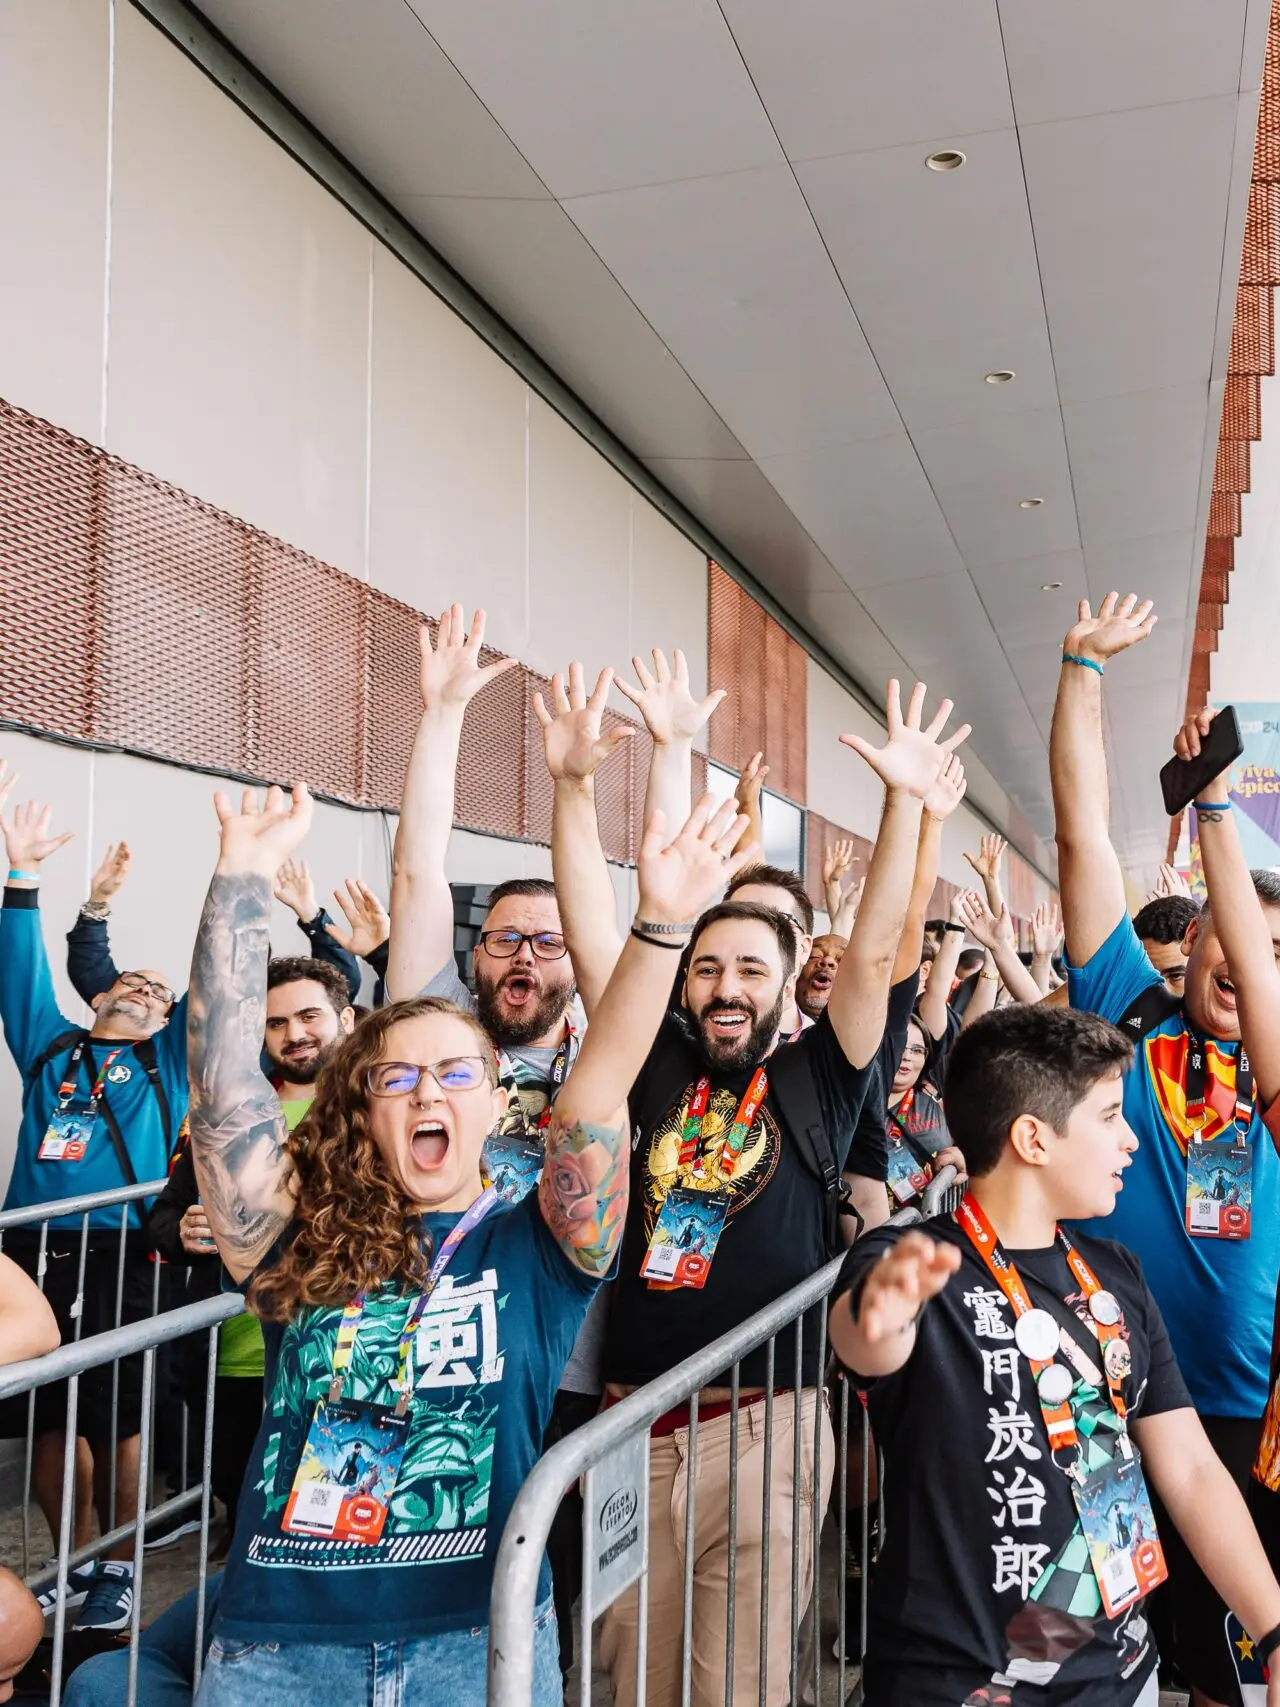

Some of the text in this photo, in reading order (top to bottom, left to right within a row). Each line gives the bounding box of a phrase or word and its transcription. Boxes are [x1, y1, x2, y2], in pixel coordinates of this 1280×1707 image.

[553, 1056, 565, 1083] CCXP24
[605, 1501, 633, 1532] EVENTOS
[608, 1491, 630, 1518] RECON
